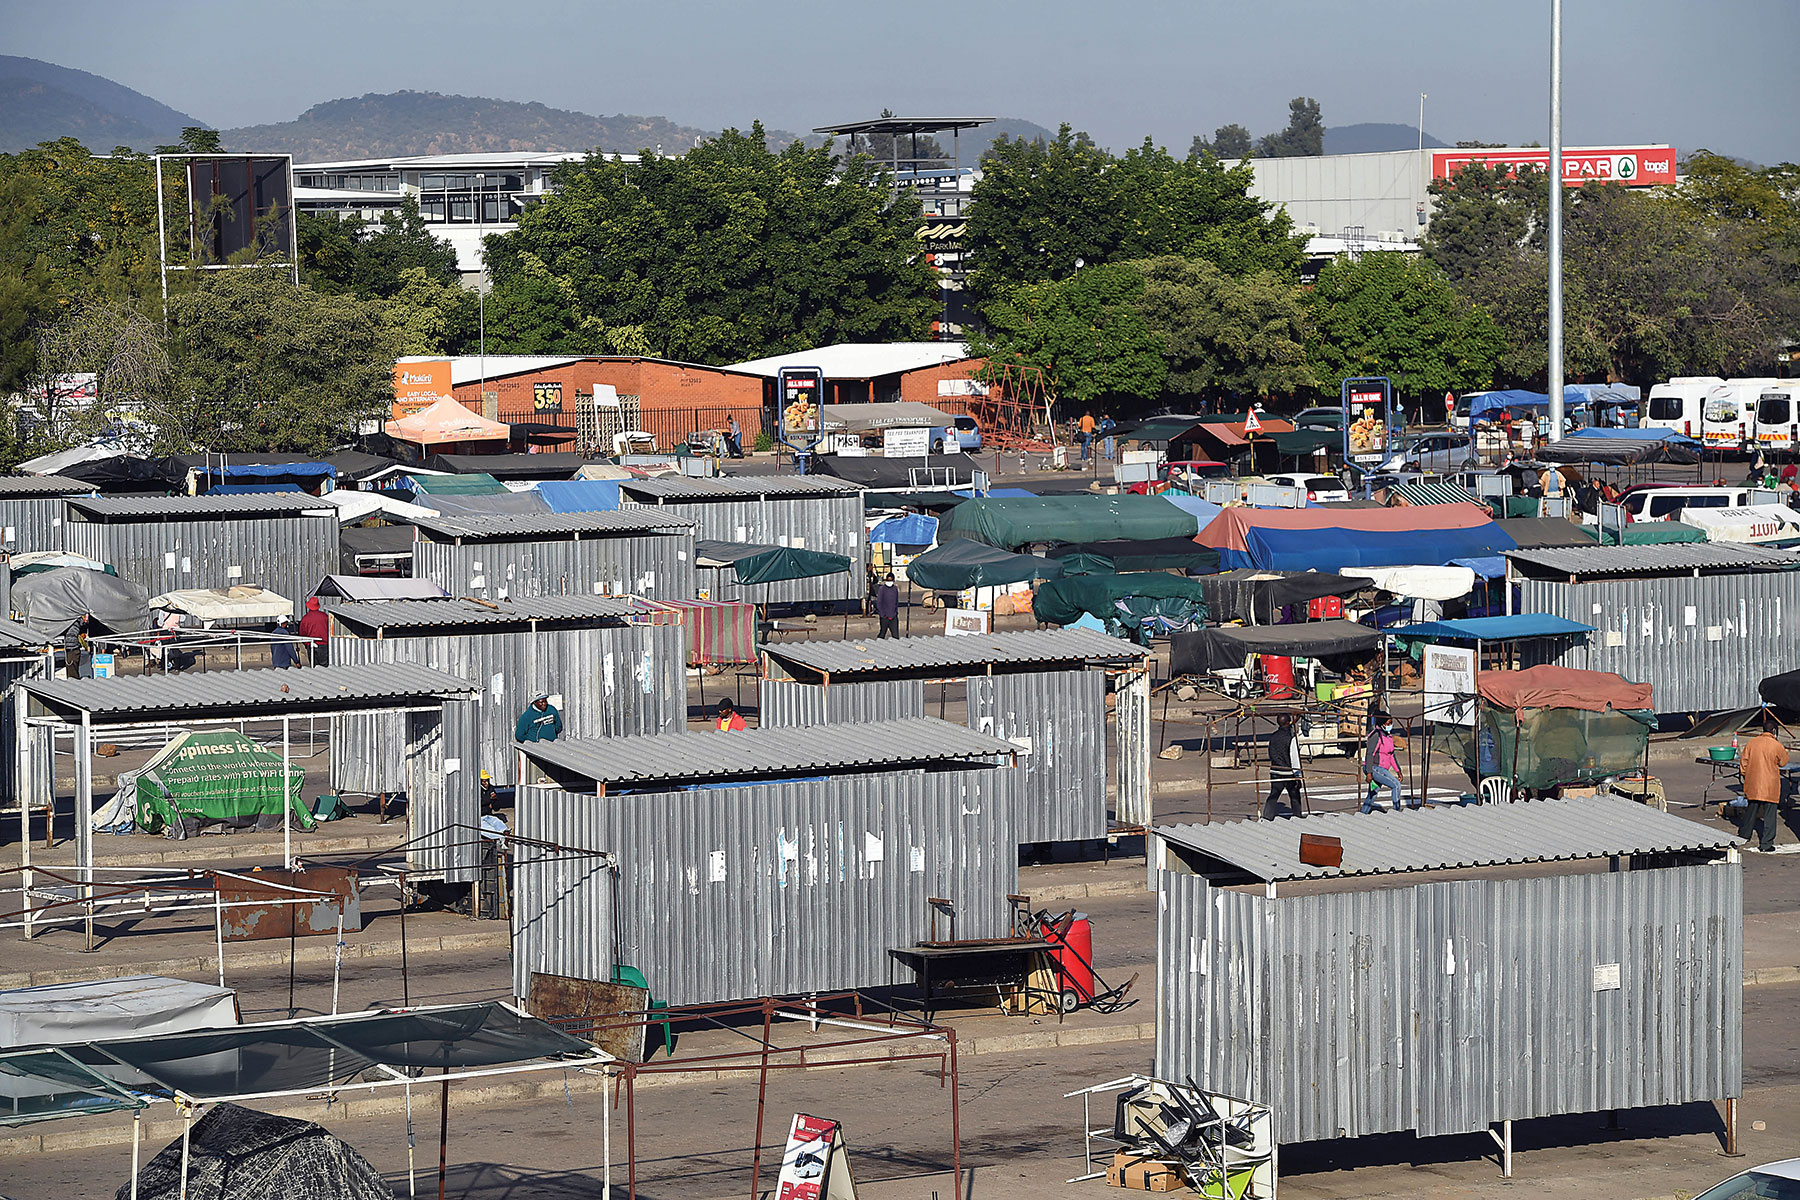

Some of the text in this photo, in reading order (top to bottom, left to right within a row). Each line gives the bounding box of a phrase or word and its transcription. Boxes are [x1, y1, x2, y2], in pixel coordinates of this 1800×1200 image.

[236, 741, 250, 753] is
[207, 762, 221, 770] the
[223, 761, 247, 770] world
[167, 773, 200, 785] Prepaid
[201, 772, 222, 782] rates
[222, 771, 241, 780] with
[242, 770, 258, 779] BTC
